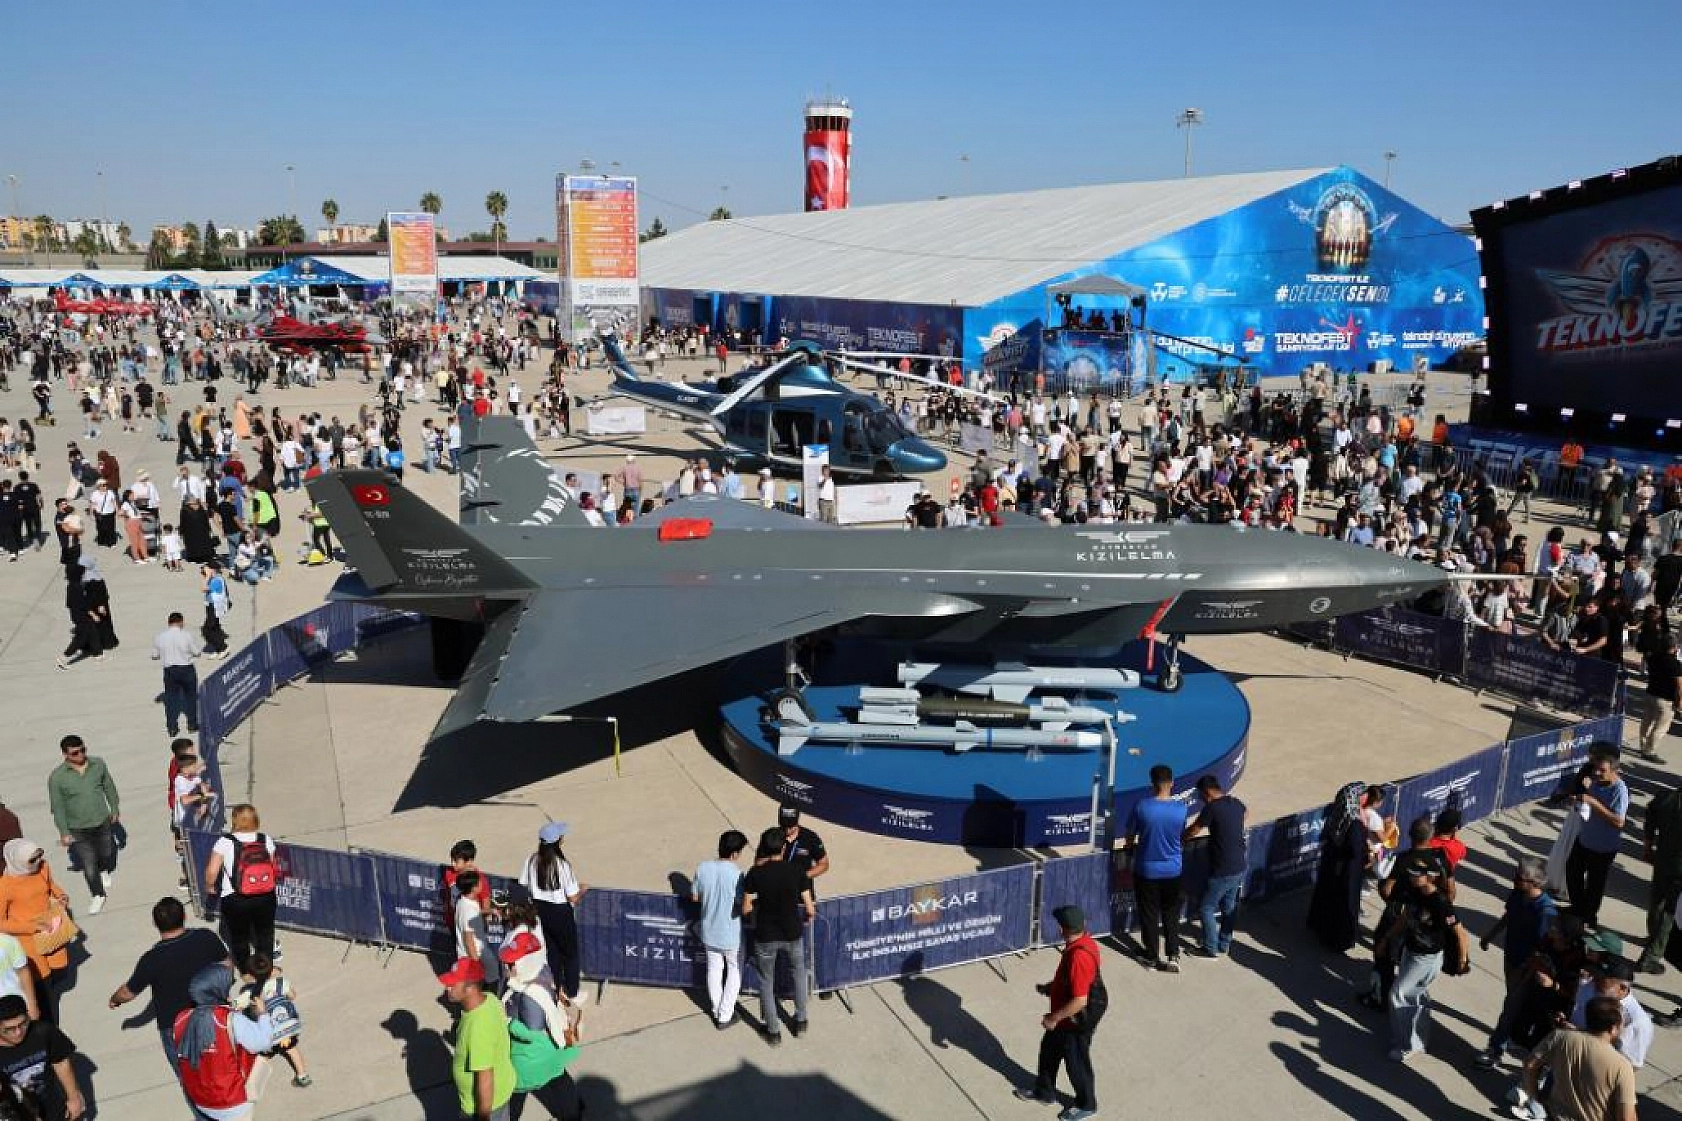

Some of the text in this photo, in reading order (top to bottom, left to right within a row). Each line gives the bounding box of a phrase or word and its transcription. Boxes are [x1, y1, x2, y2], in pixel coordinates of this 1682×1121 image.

[1537, 301, 1682, 351] TEKNOFE
[1274, 331, 1353, 344] TEKNOFEST
[1076, 550, 1176, 561] KIZILELMA
[1044, 826, 1090, 836] KIZILELM
[888, 891, 978, 919] BAYKAR
[625, 944, 693, 962] KIZIL
